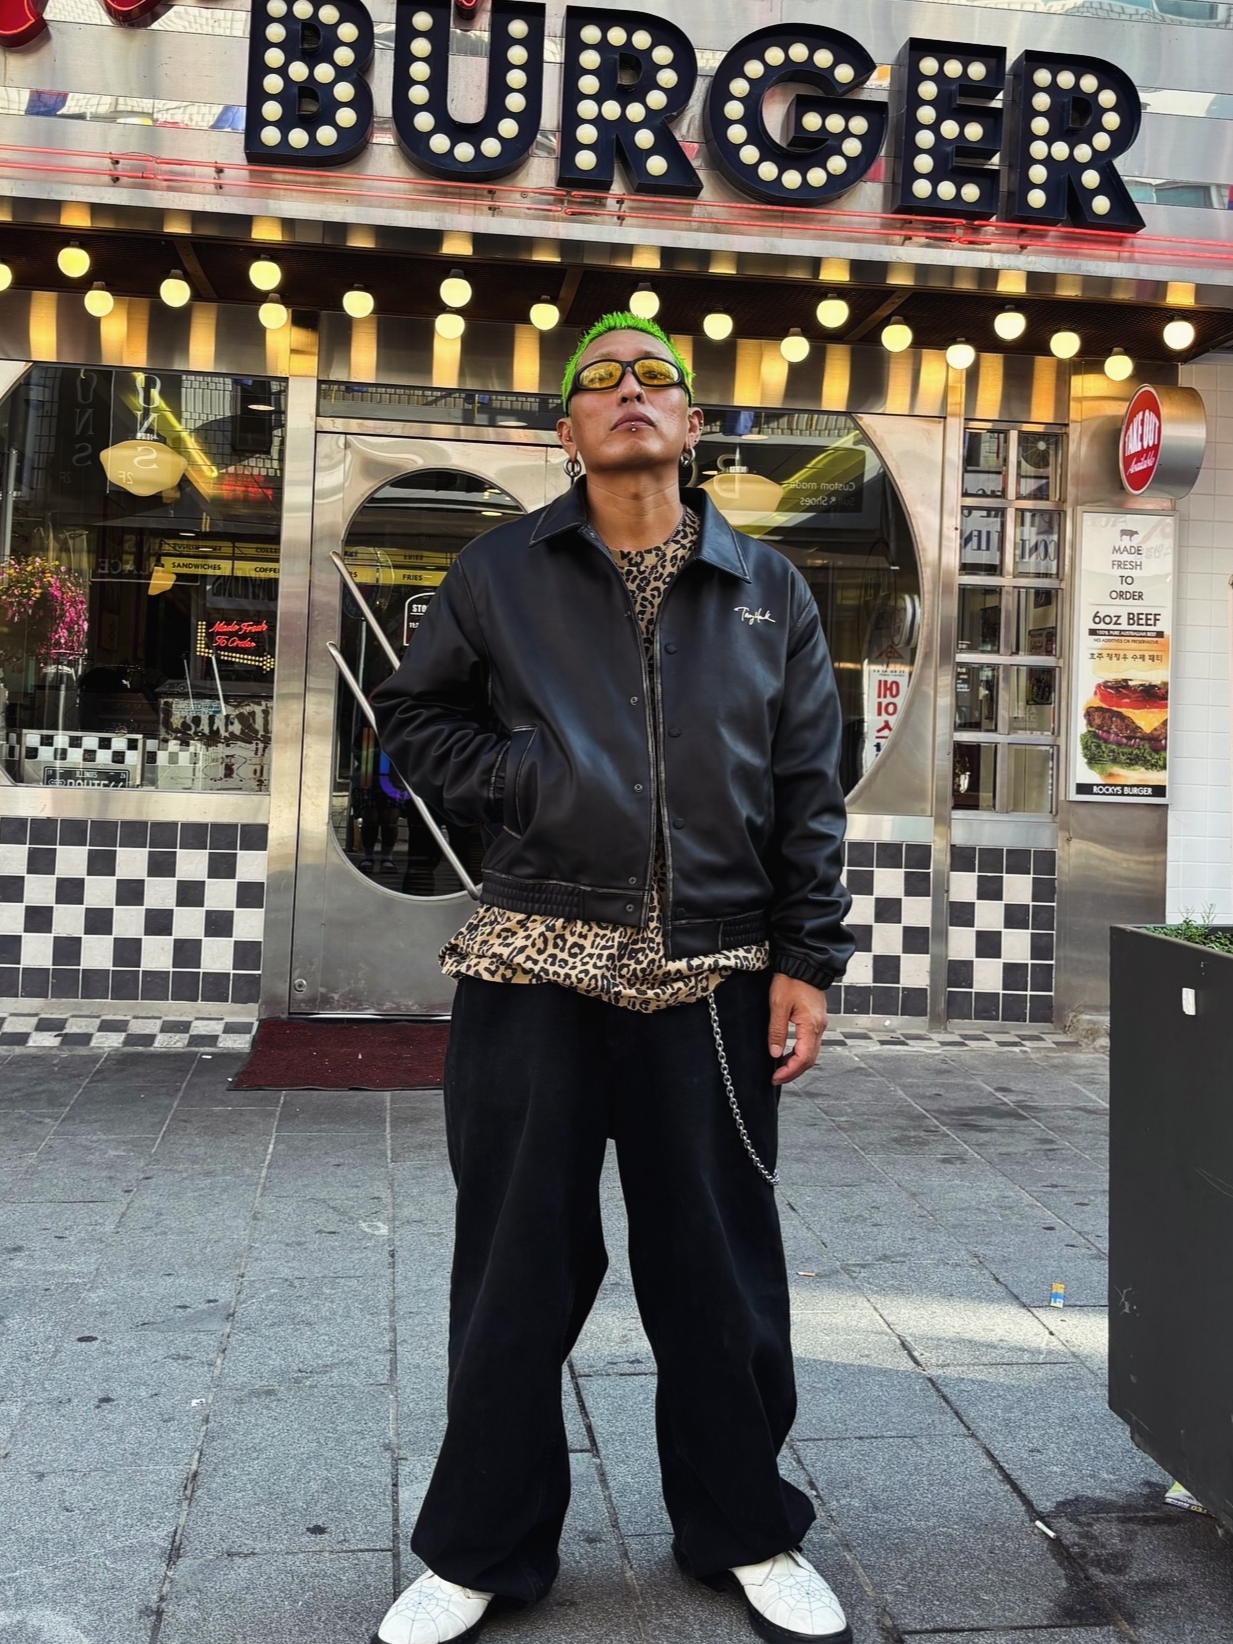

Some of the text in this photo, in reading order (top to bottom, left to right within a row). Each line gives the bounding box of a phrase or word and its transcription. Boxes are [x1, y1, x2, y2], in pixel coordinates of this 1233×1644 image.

[245, 0, 1146, 232] BURGER
[1125, 409, 1160, 456] TAKE OUT
[1126, 450, 1155, 475] Available
[1112, 545, 1143, 556] MADE
[171, 562, 222, 571] SANDWICHES
[1111, 560, 1143, 571] FRESH
[402, 573, 423, 581] FRIES
[1119, 575, 1135, 586] TO
[1109, 590, 1144, 601] ORDER
[412, 604, 429, 613] STO
[1092, 610, 1162, 627] 6oz BEEF
[209, 620, 268, 634] Made Fresh
[213, 635, 256, 648] To Order
[1088, 653, 1104, 661] 호주
[1131, 654, 1146, 662] 수제
[1092, 786, 1153, 795] ROCKYS BURGER
